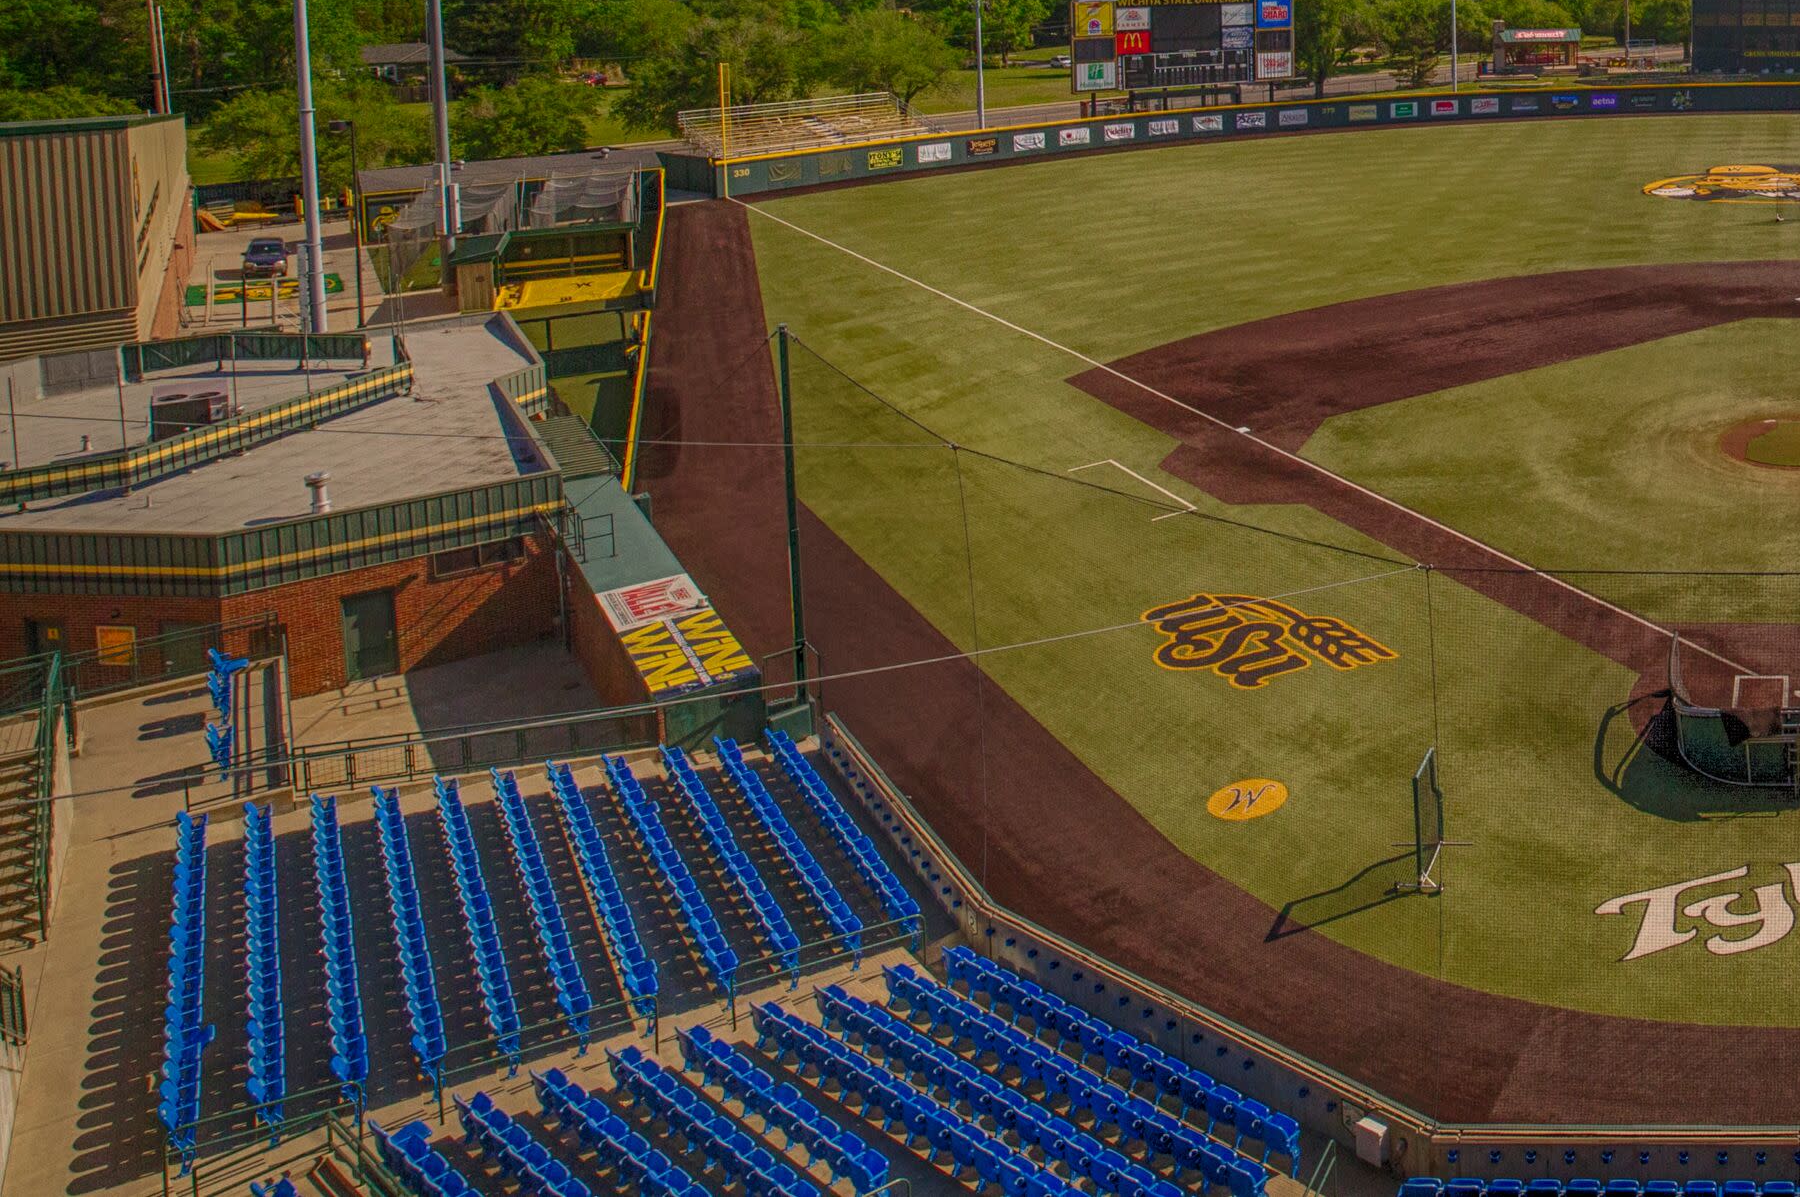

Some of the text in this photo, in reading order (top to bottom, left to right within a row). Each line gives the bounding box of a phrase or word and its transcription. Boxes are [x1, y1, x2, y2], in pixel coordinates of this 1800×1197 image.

[1263, 9, 1288, 20] GUARD
[1592, 97, 1615, 106] aetna
[733, 168, 749, 178] 330
[676, 609, 754, 675] WIN!
[621, 621, 699, 692] WIN!
